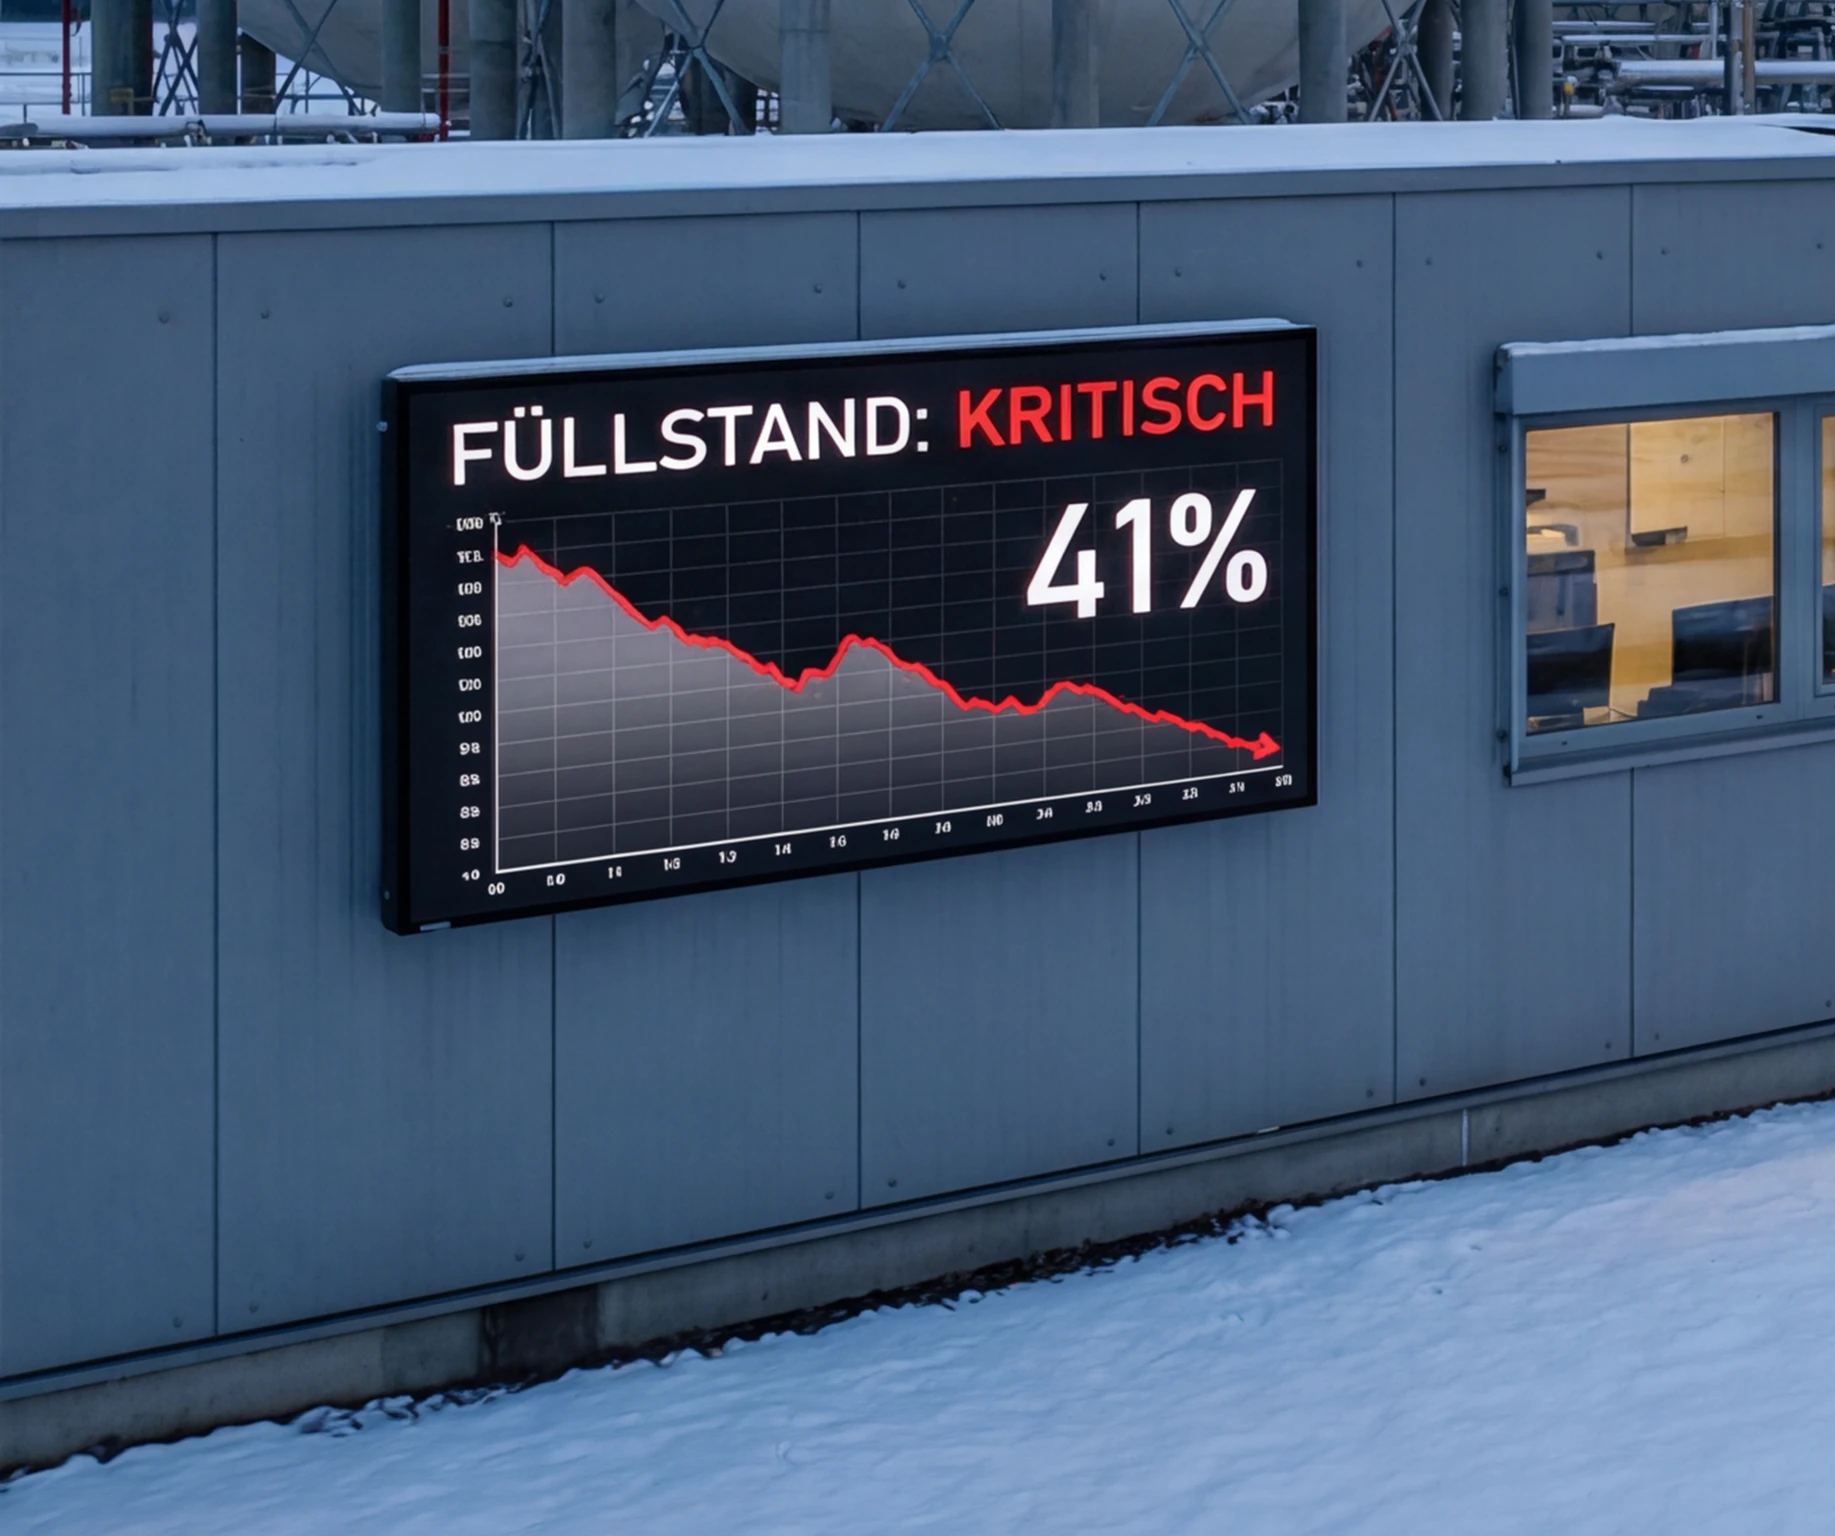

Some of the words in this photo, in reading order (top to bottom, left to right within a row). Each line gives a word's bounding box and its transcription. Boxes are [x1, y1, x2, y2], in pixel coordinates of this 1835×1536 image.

[452, 395, 930, 486] FÜLLSTAND:
[957, 370, 1275, 449] KRITISCH
[1026, 488, 1269, 620] 41%
